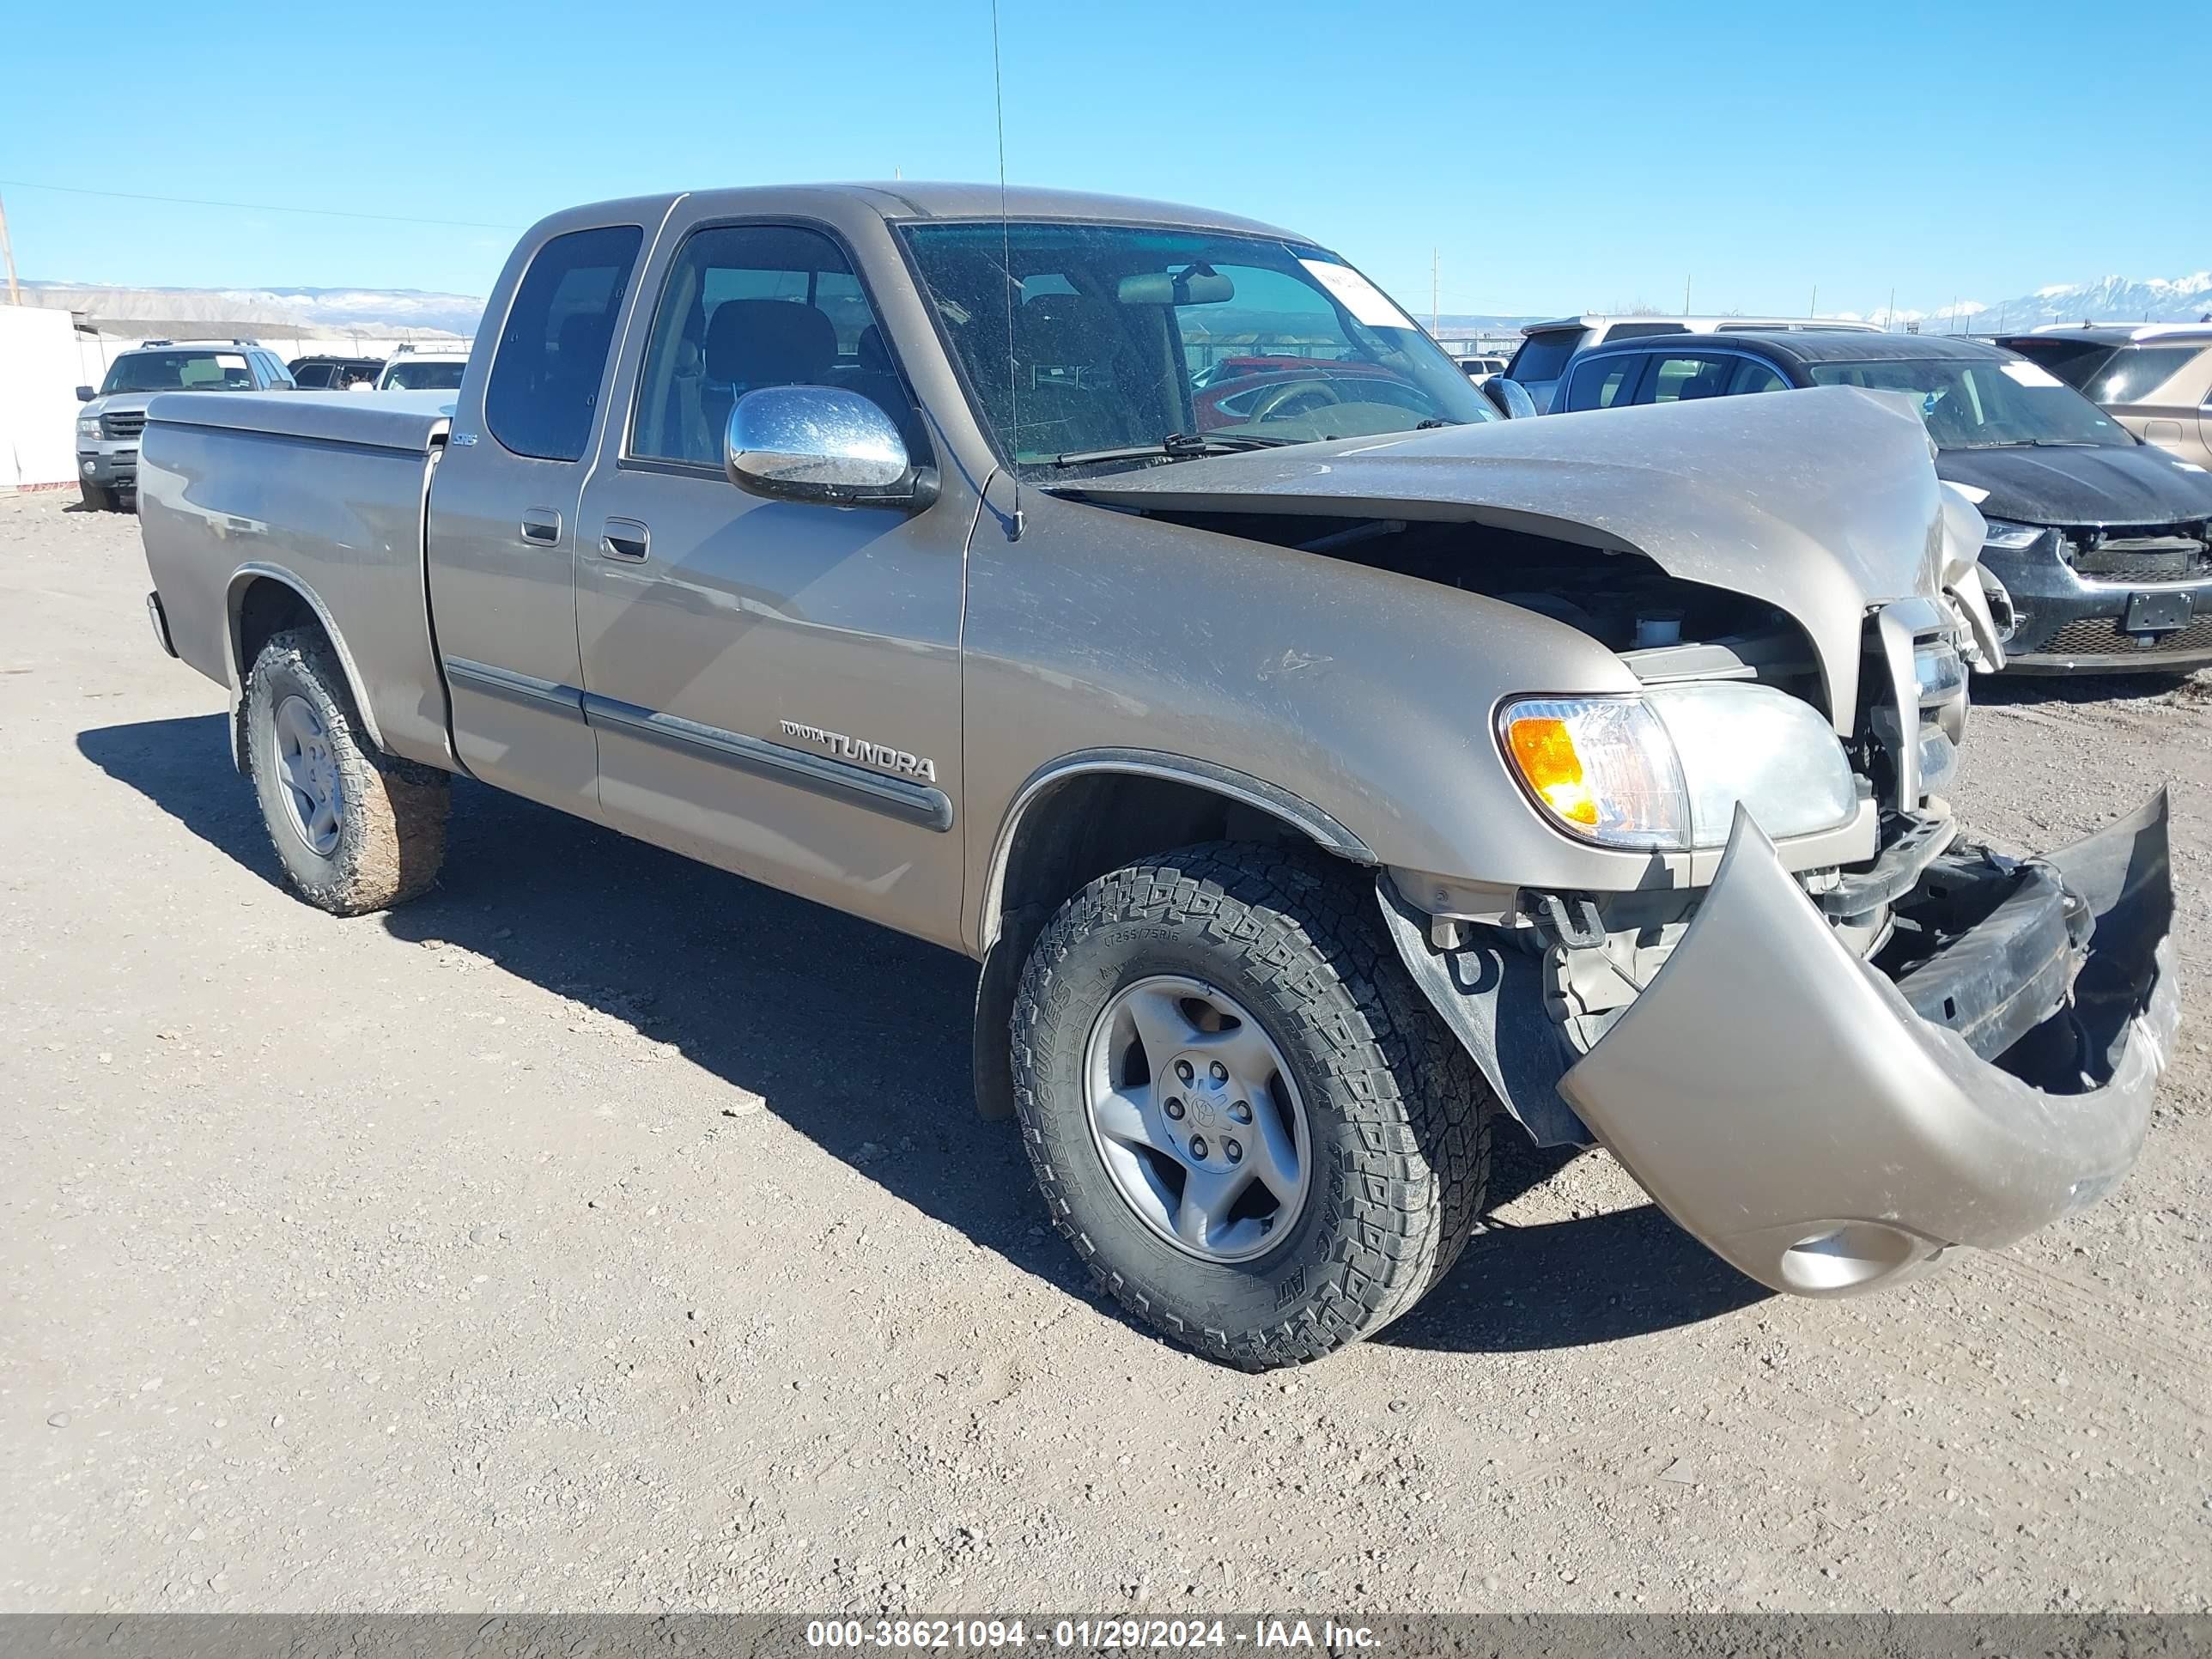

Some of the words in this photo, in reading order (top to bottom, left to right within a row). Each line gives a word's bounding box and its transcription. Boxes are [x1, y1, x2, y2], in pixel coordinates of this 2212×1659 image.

[780, 719, 826, 744] TOYOTA
[823, 731, 937, 783] TUNDRA
[1103, 927, 1182, 948] LT265/75R16
[1033, 976, 1085, 1198] HERCULES
